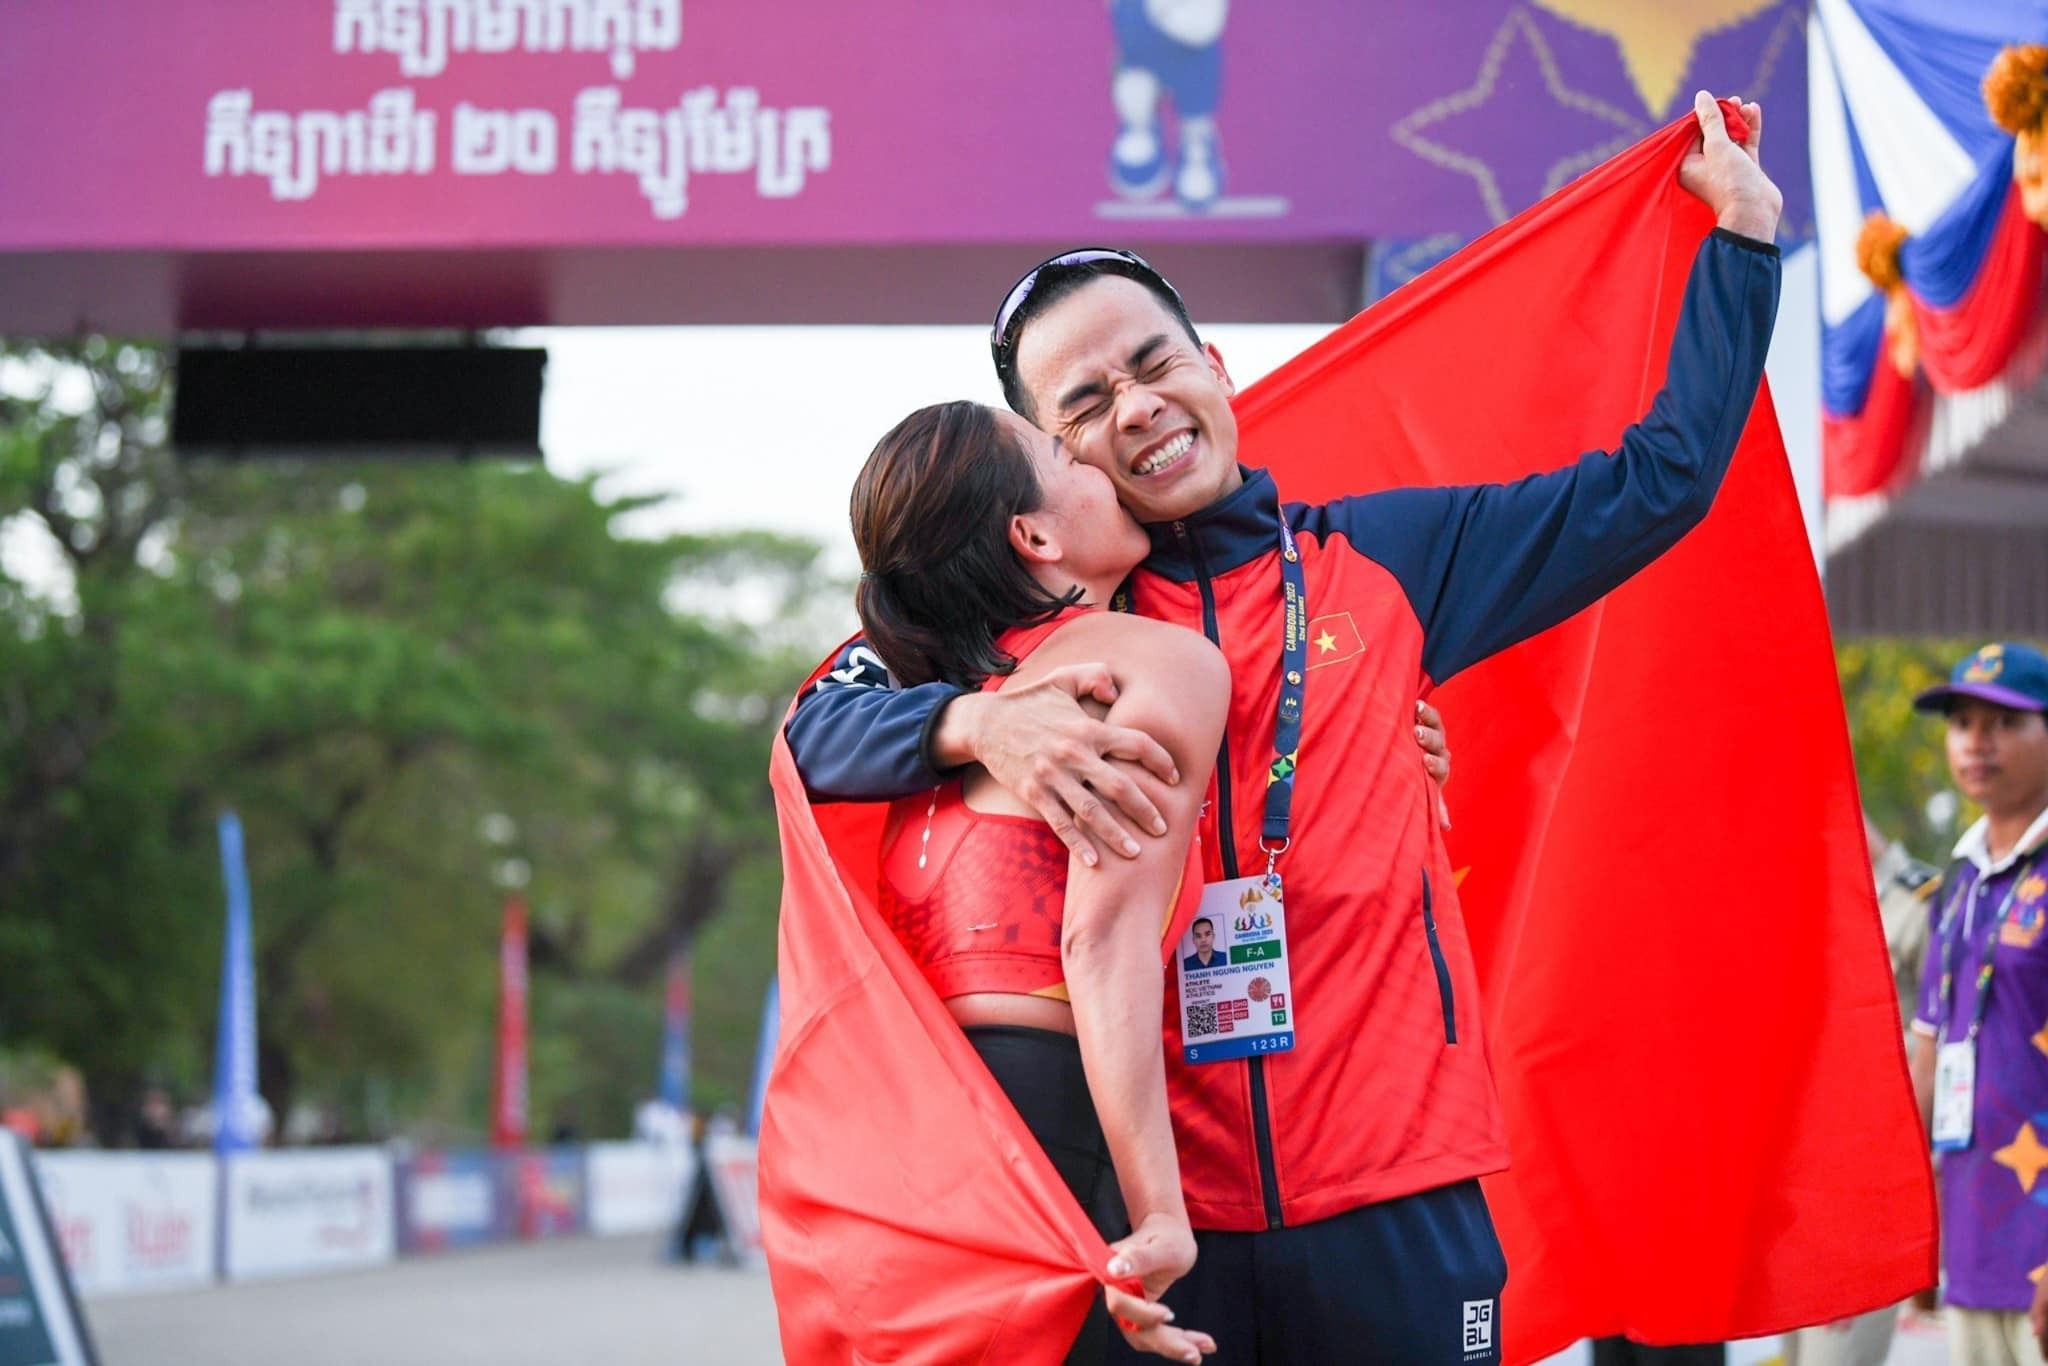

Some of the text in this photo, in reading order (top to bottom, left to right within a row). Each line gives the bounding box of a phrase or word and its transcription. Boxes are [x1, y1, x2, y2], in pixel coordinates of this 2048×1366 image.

[452, 102, 558, 174] ២០
[1286, 582, 1297, 652] CAMBODIA 2023
[1246, 946, 1265, 958] F-A
[1184, 961, 1274, 980] THANH NGUNG NGUYEN
[1185, 979, 1210, 987] ATHLETE
[1190, 1049, 1199, 1059] S
[1466, 1305, 1490, 1324] JG
[1466, 1327, 1488, 1346] BL
